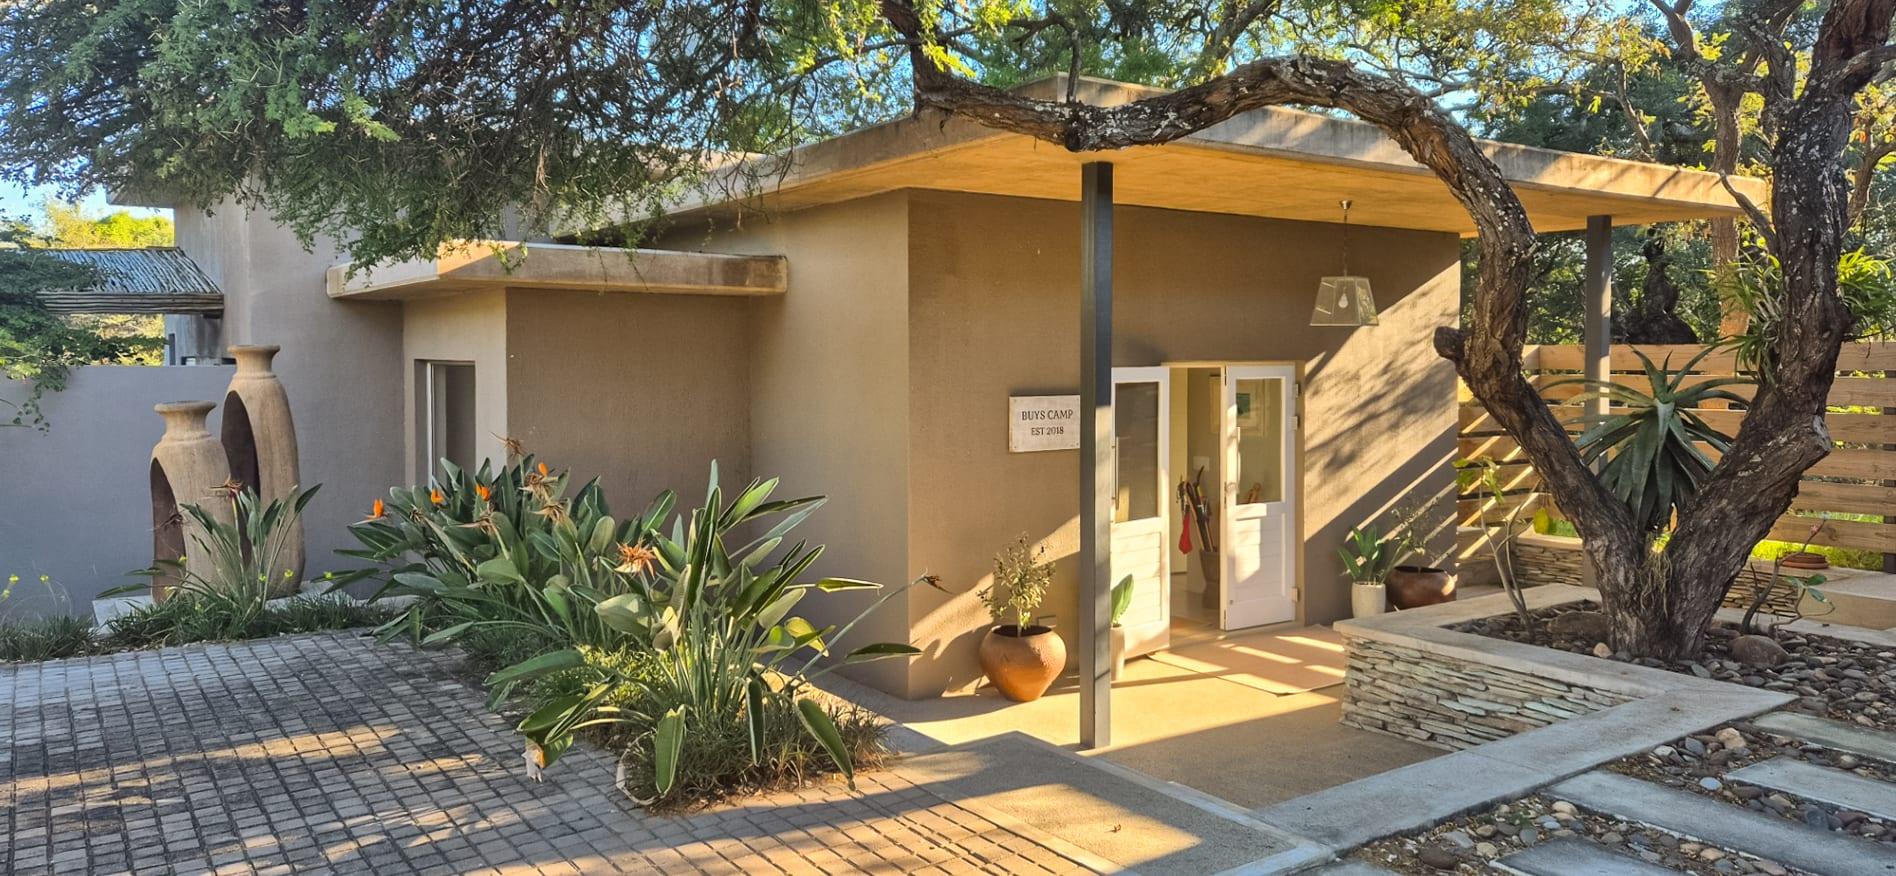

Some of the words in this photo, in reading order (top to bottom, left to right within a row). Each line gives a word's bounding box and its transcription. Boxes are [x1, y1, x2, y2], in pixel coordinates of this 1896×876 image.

[1021, 410, 1046, 421] BUYS
[1047, 409, 1074, 420] CAMP
[1031, 427, 1045, 436] EST
[1046, 426, 1064, 436] 2018
